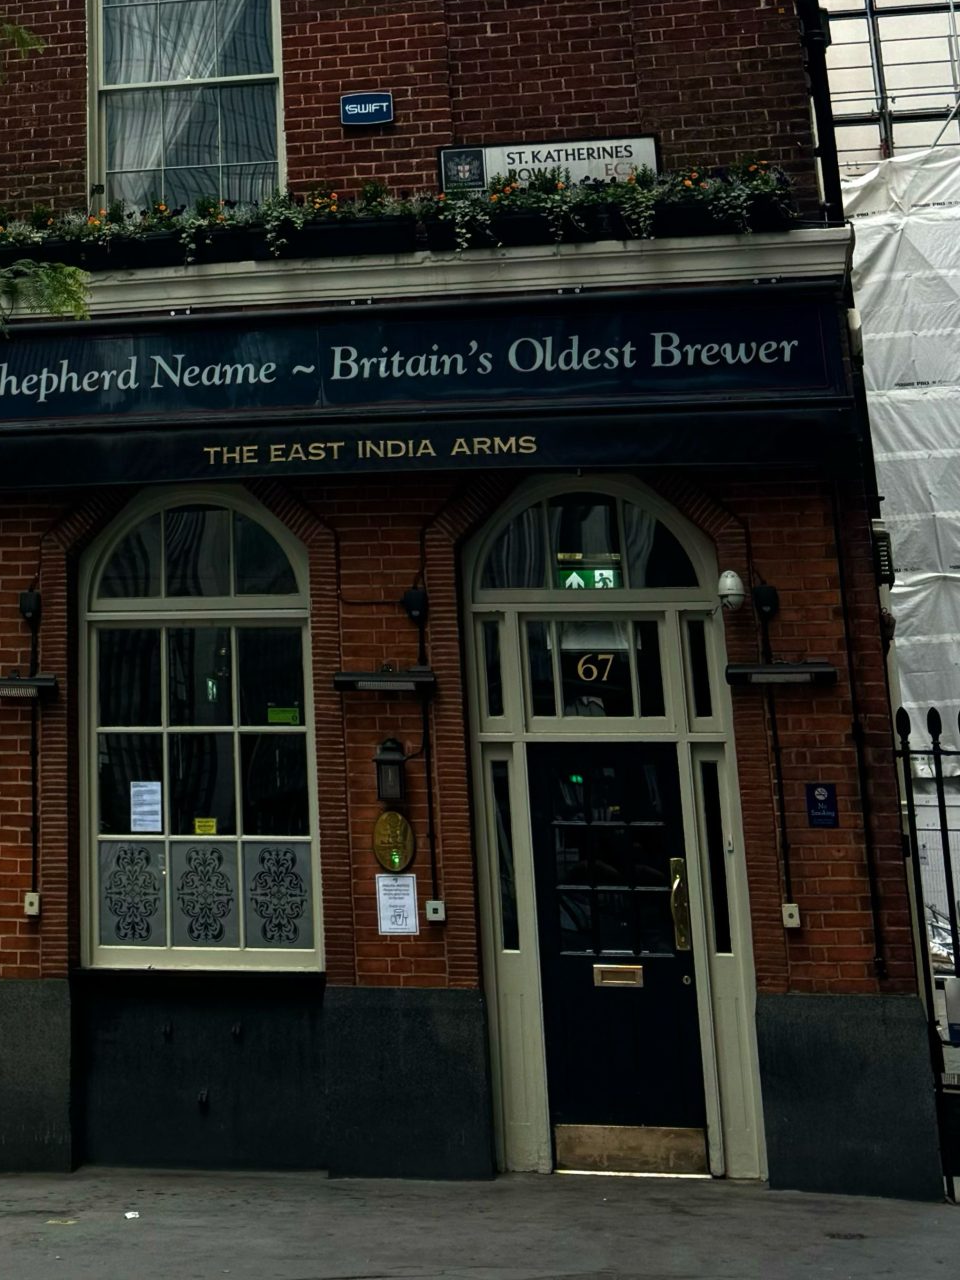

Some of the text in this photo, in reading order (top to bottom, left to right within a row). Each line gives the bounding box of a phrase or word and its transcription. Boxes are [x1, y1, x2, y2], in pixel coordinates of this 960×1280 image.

[345, 102, 389, 115] SWIFT
[507, 145, 633, 165] ST. KATHERINES
[149, 353, 278, 389] Neame
[330, 339, 493, 381] Britain's
[508, 335, 637, 373] Oldest
[651, 331, 798, 368] Brewer
[203, 435, 538, 465] THE EAST INDIA ARMS
[577, 653, 614, 682] 67
